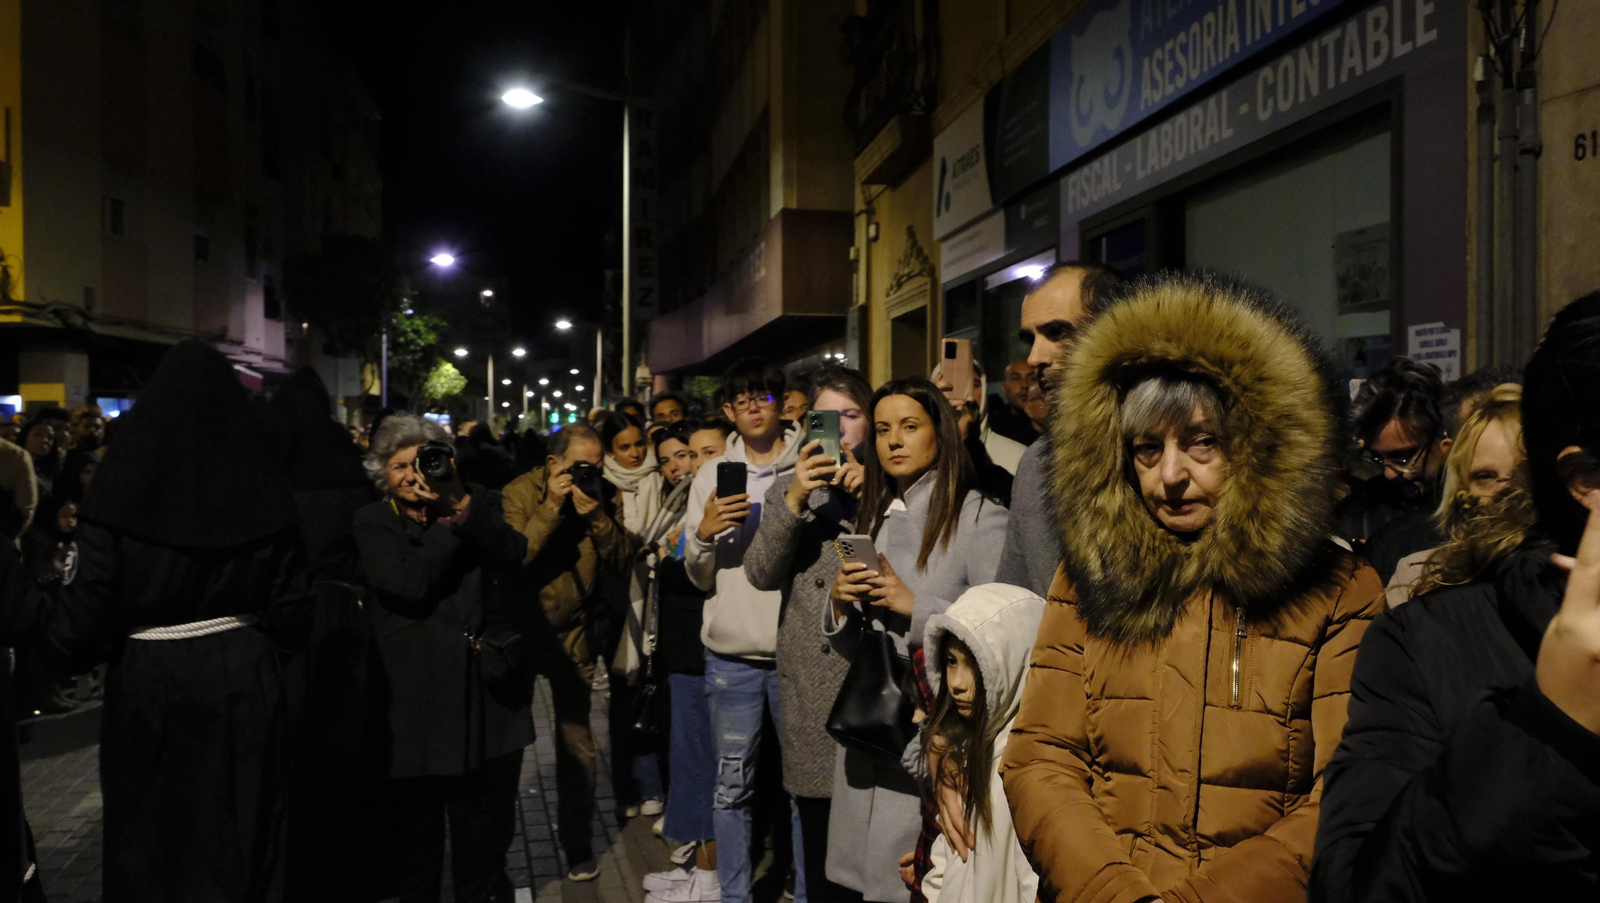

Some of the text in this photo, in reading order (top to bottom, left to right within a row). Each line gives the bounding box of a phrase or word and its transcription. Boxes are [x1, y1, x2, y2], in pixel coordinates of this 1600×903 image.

[1066, 151, 1122, 215] FISCAL
[1135, 88, 1235, 181] LABORAL
[1256, 0, 1439, 122] CONTABLE
[1573, 129, 1598, 161] 61
[635, 108, 655, 308] RAMIREZ
